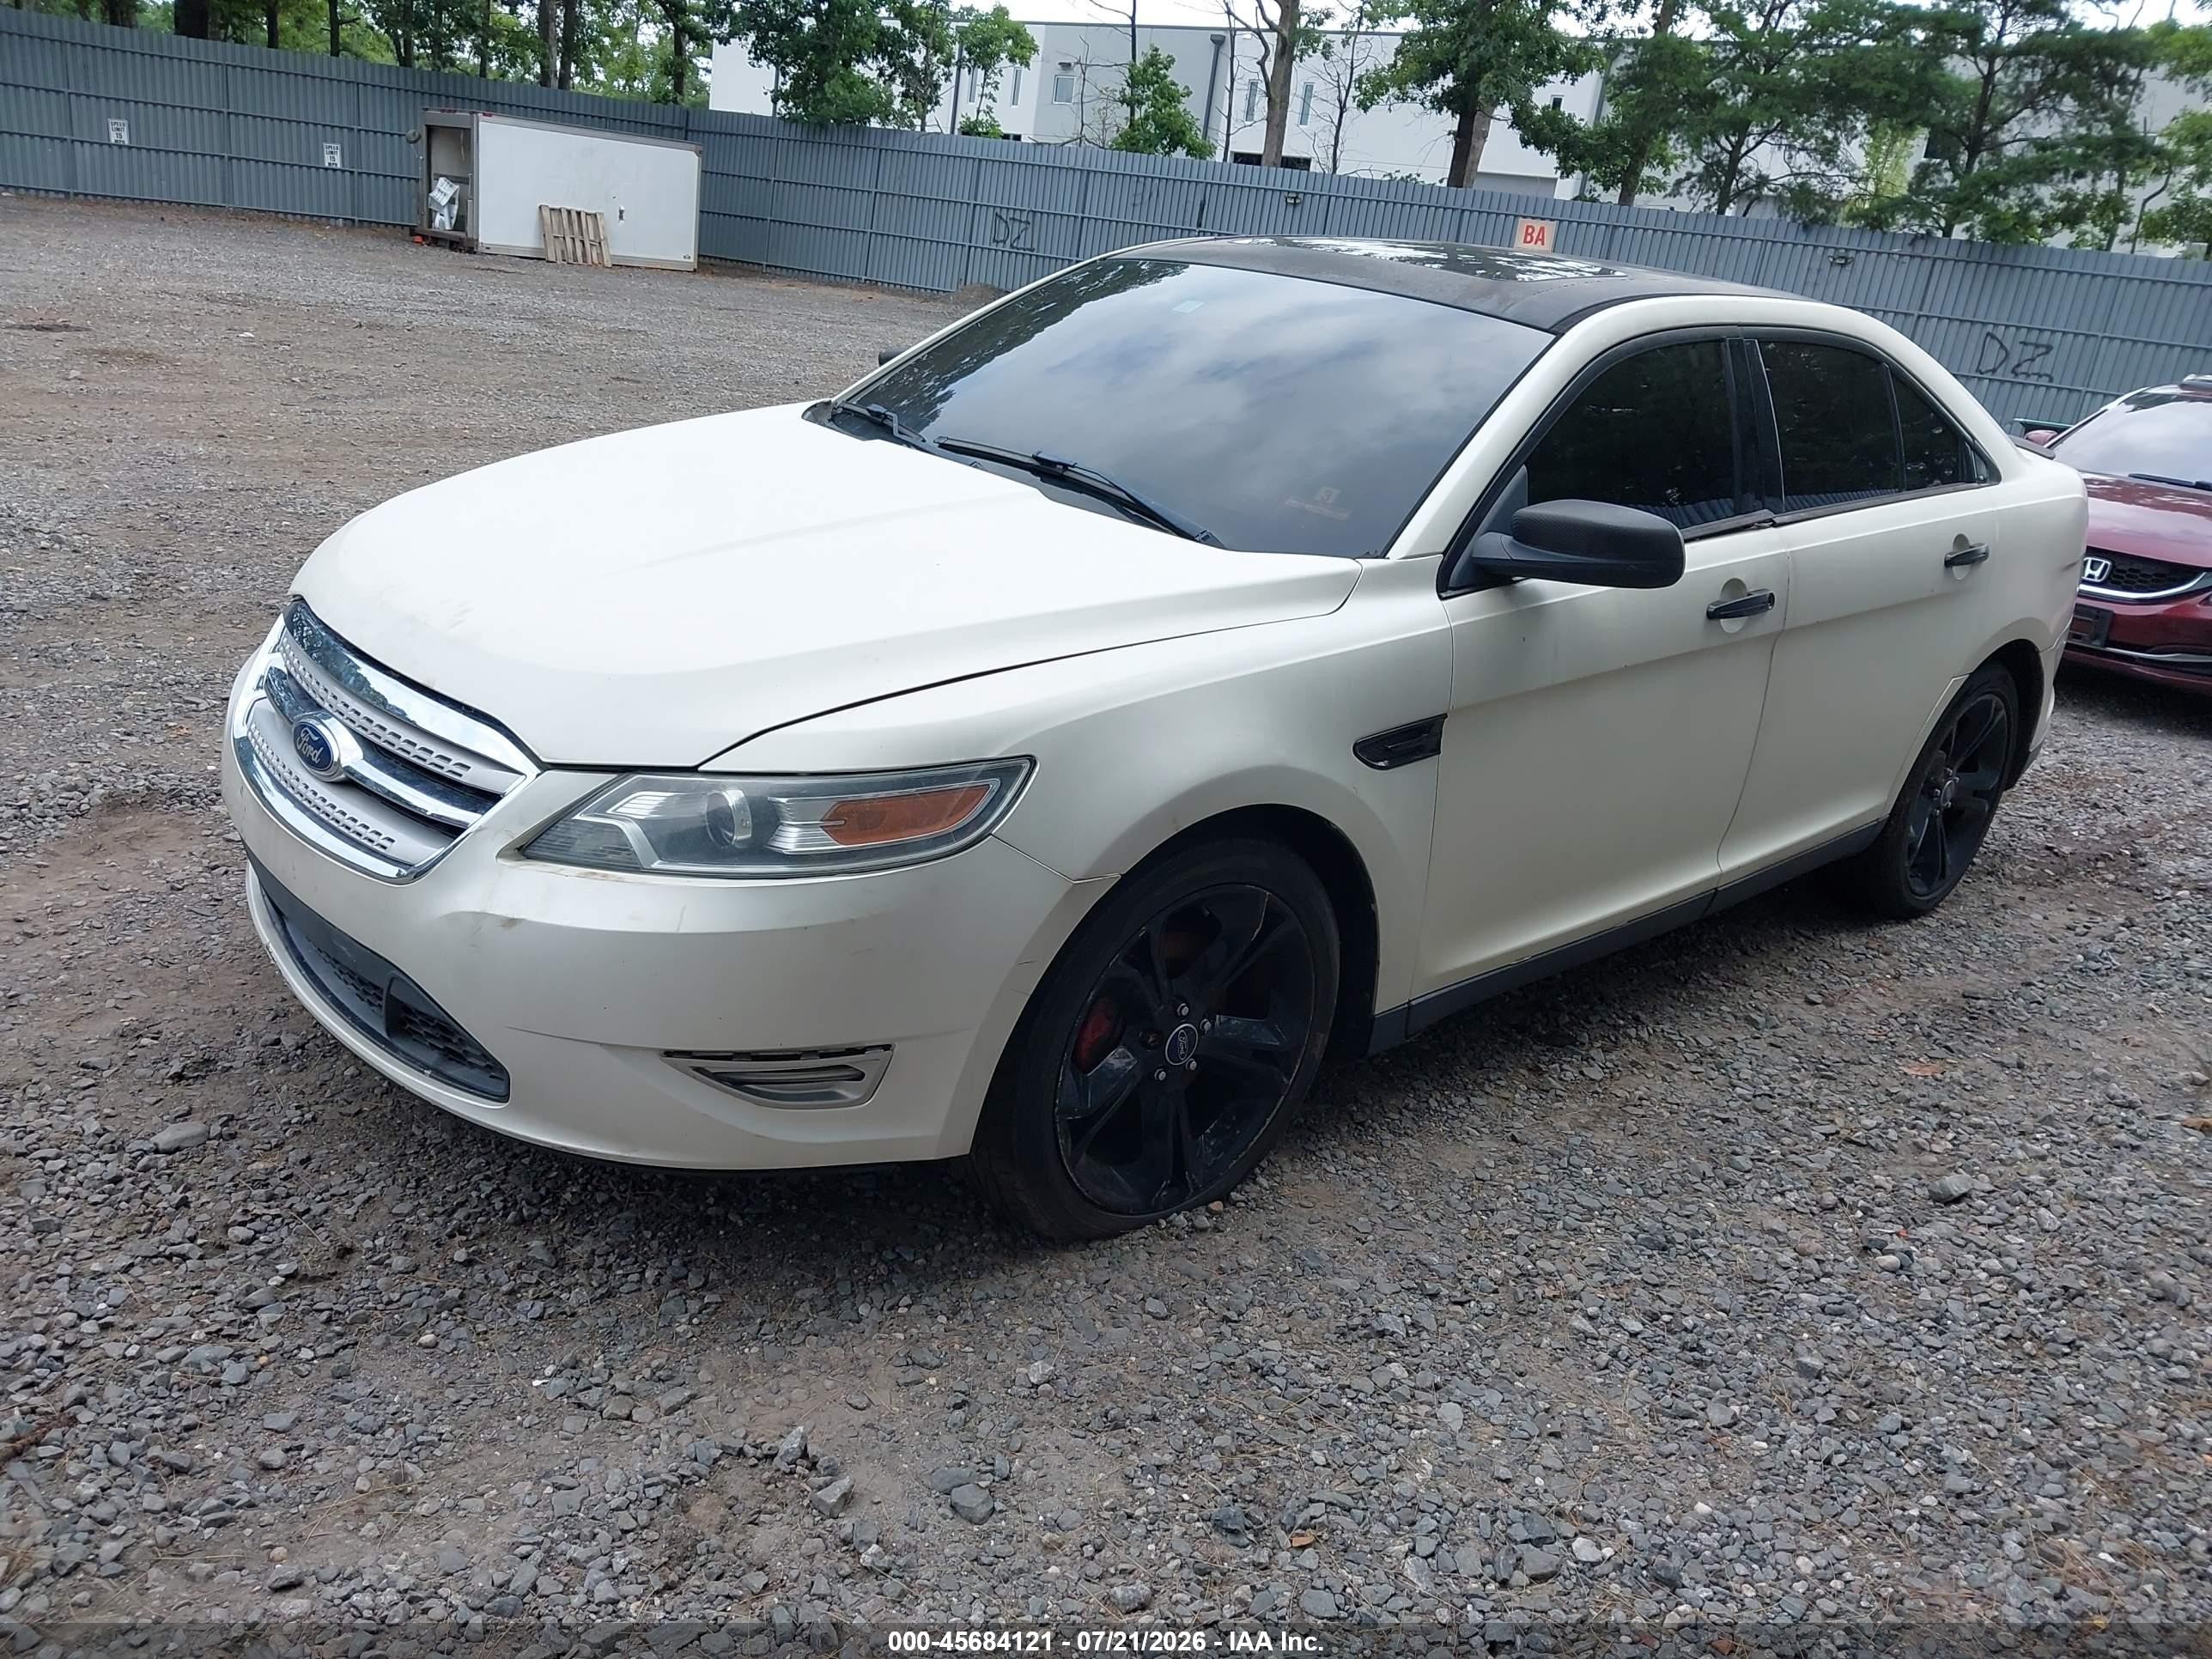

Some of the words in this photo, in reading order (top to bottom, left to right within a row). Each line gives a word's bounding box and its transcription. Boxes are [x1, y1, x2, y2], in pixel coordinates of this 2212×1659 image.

[1522, 224, 1546, 246] BA
[1975, 331, 2054, 384] DZ
[296, 726, 325, 764] Ford
